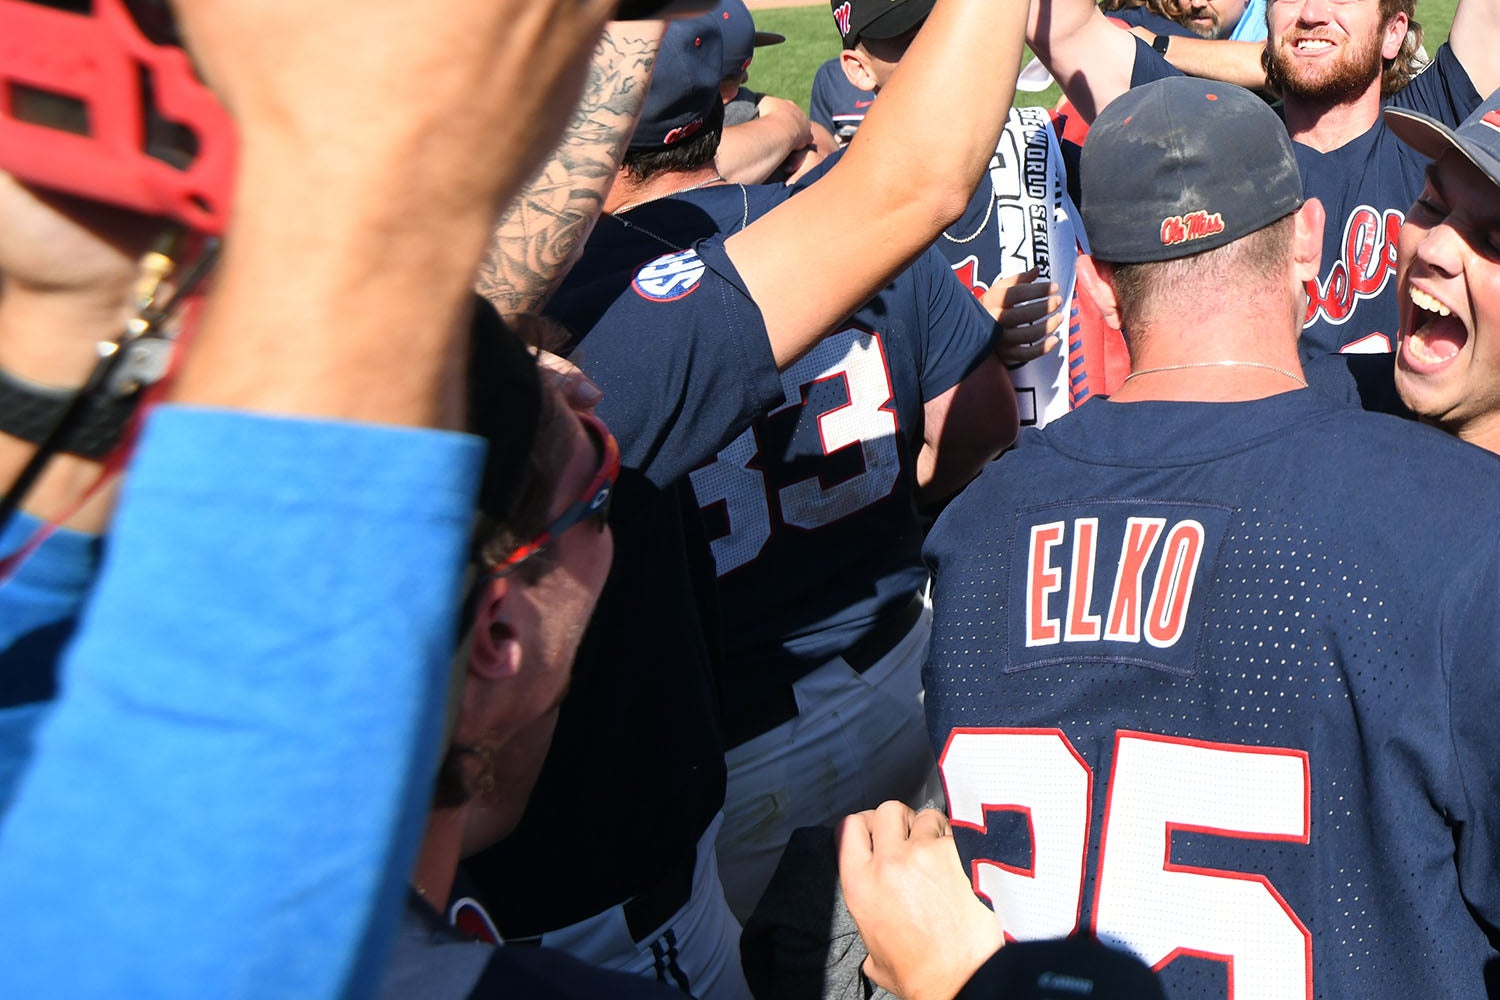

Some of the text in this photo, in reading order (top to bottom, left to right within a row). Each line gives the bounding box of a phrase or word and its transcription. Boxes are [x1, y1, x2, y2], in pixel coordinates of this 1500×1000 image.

[1023, 130, 1049, 199] WORLD
[1029, 204, 1051, 280] SERIES
[1161, 210, 1225, 246] Ole Miss
[1025, 516, 1206, 649] ELKO
[938, 727, 1314, 1000] 25
